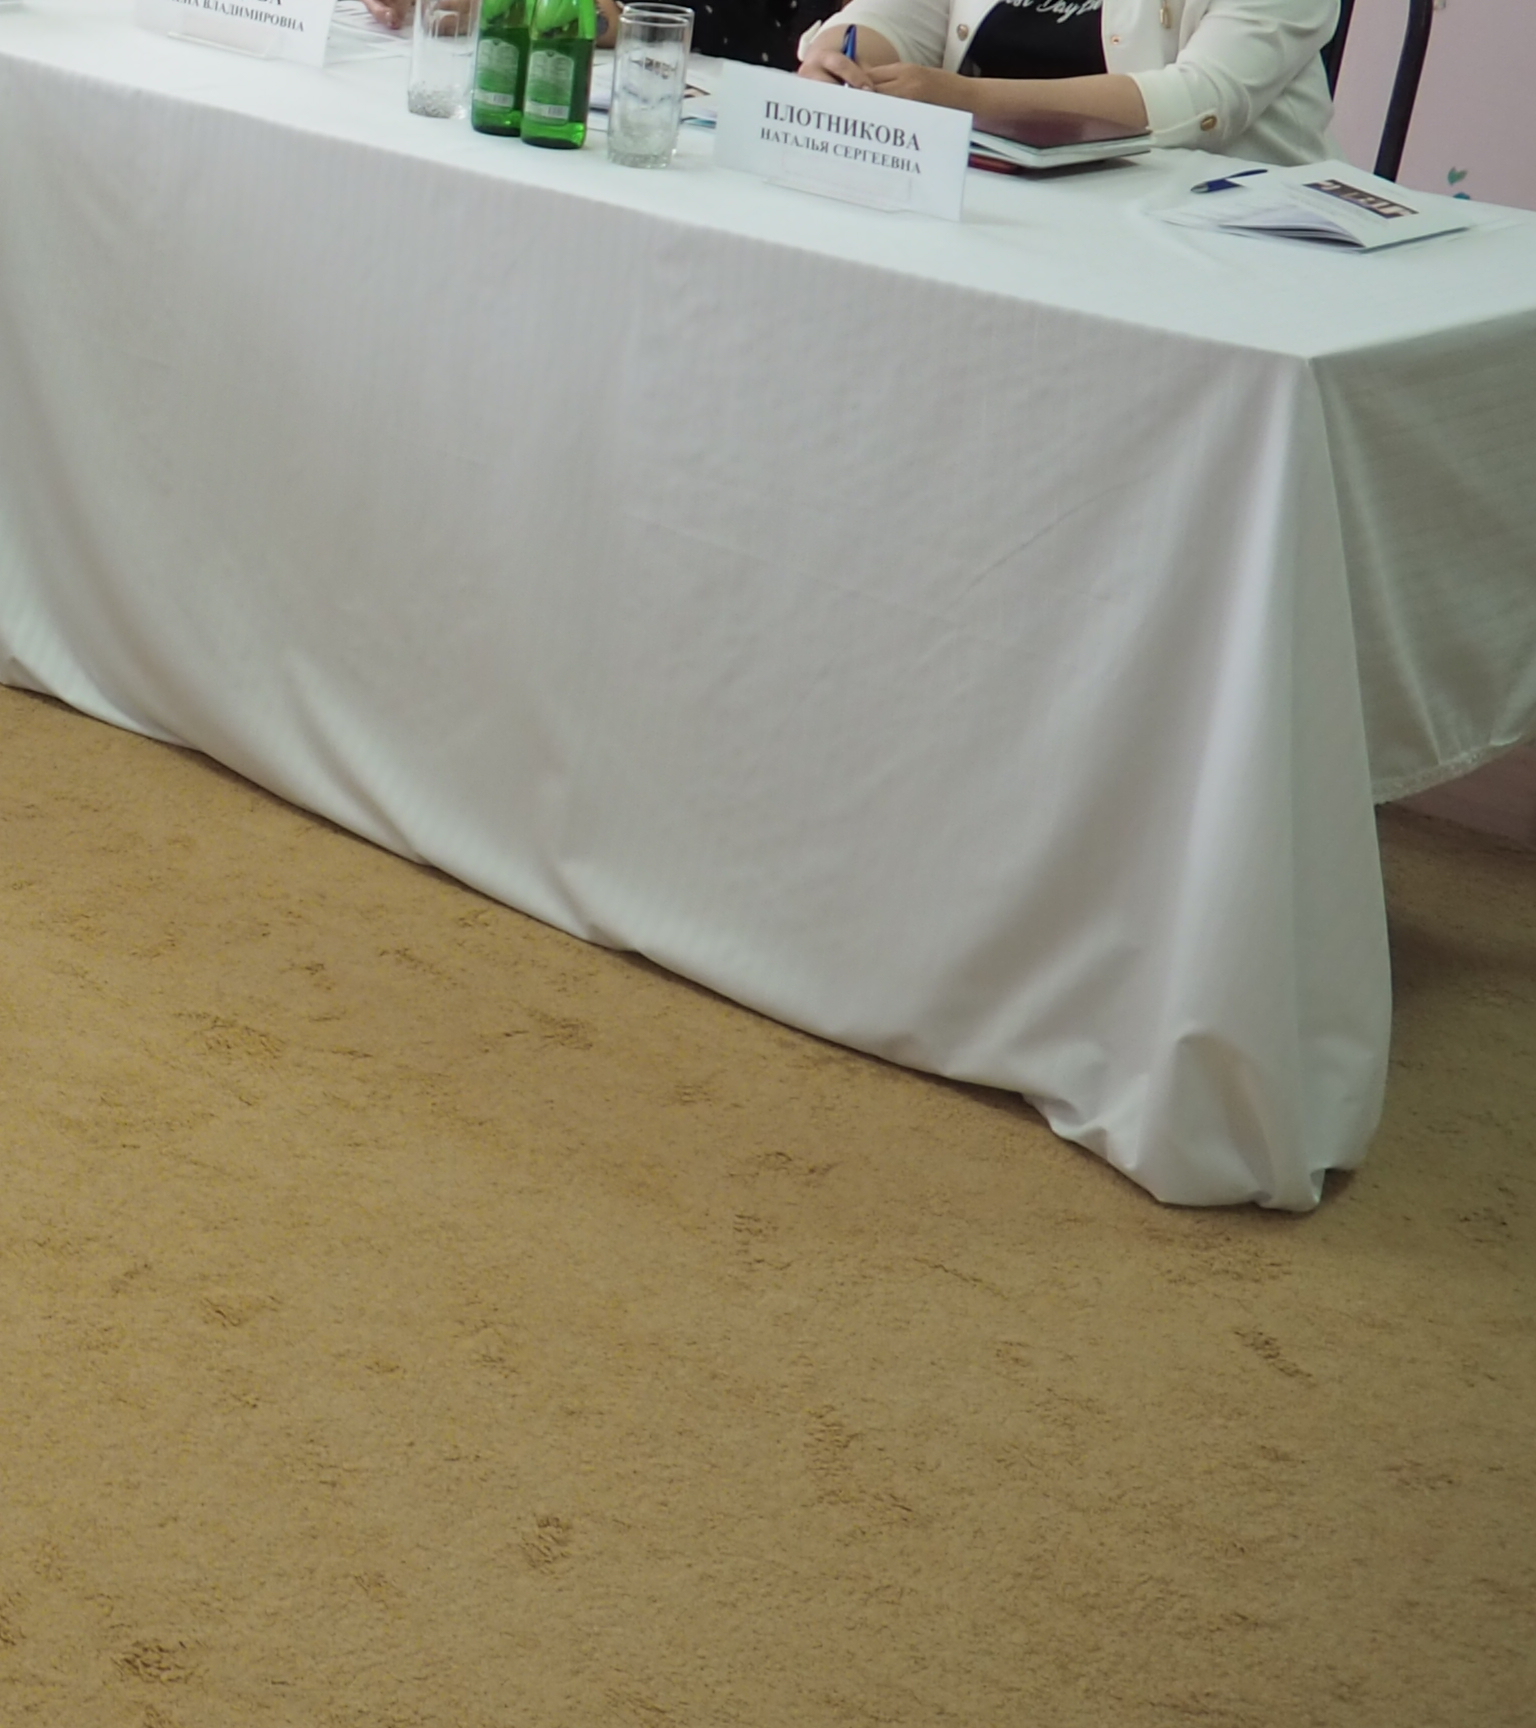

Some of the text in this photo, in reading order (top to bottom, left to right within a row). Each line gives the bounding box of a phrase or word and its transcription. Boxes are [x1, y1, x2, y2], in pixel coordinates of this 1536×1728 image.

[760, 127, 921, 174] НАТАЛЬЯ СЕРГЕЕВНА
[764, 100, 921, 152] ПЛОТНИКОВА
